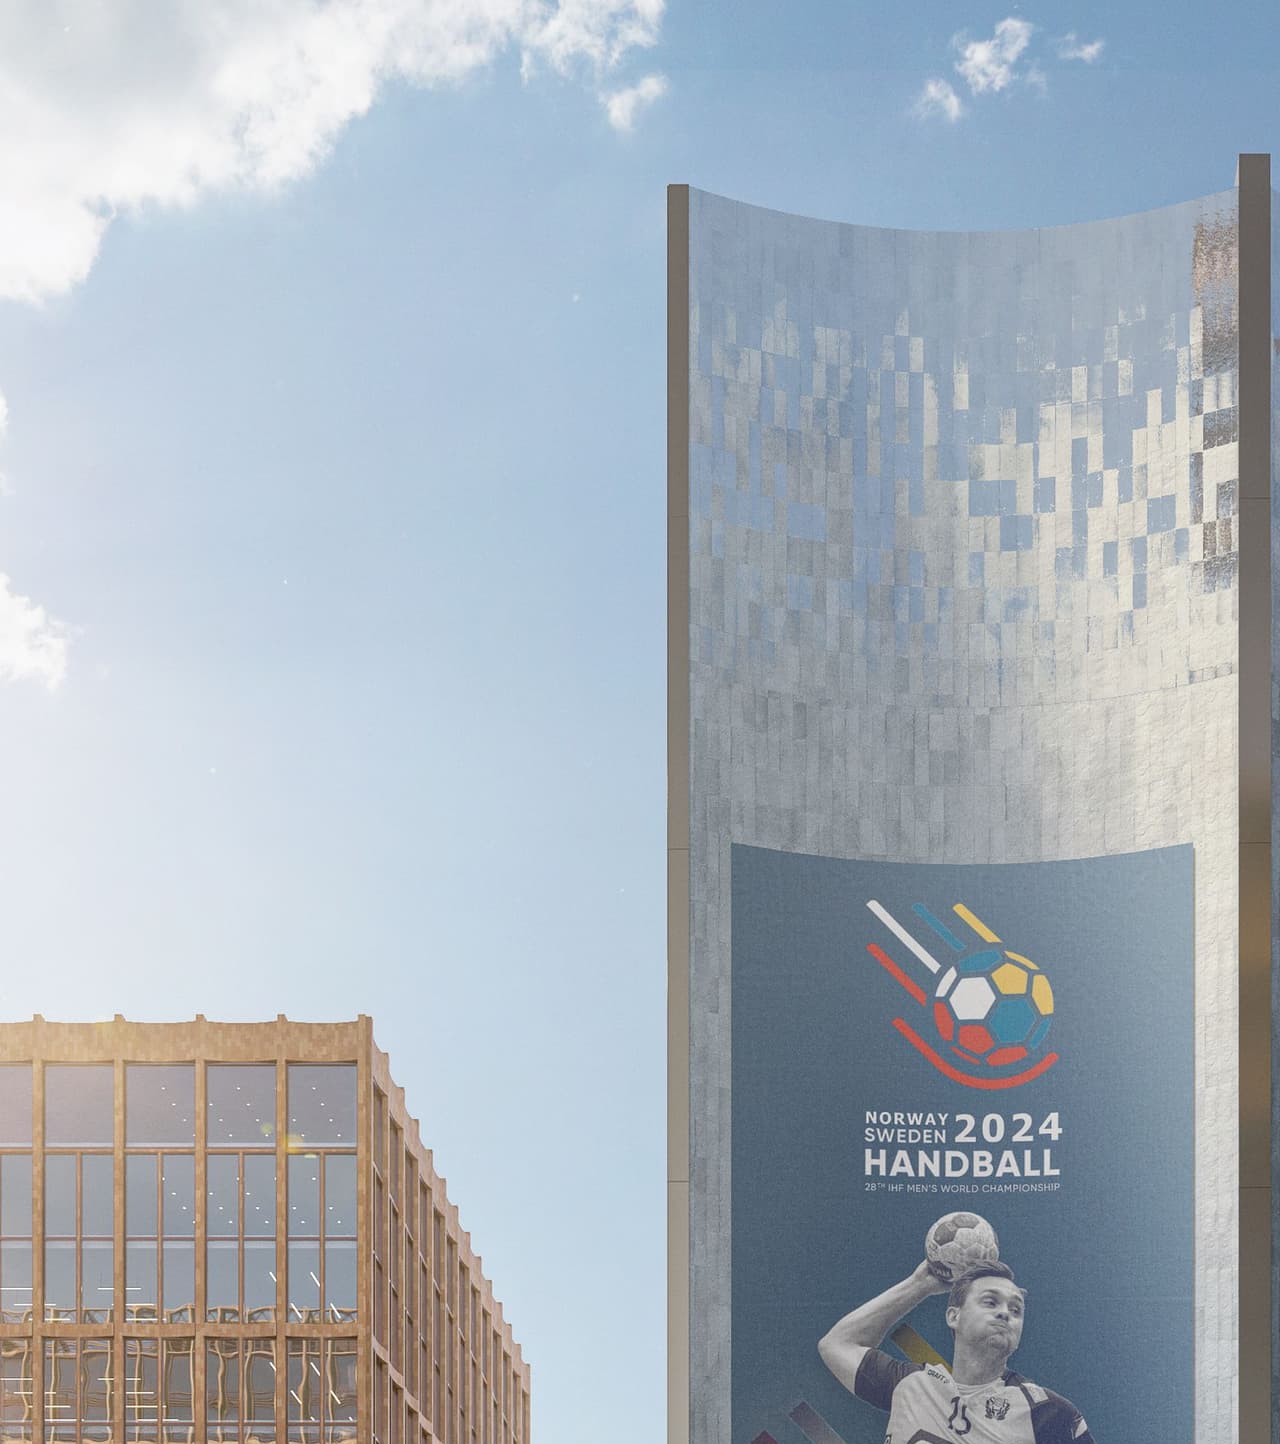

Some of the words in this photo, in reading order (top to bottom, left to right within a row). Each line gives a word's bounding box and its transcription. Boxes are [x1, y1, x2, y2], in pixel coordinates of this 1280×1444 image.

[865, 1111, 949, 1126] NORWAY
[954, 1111, 1063, 1143] 2024
[864, 1127, 947, 1144] SWEDEN
[864, 1148, 1061, 1177] HANDBALL
[888, 1183, 905, 1193] IHF
[906, 1184, 938, 1193] MEN'S
[940, 1184, 979, 1193] WORLD
[981, 1182, 1061, 1193] CHAMPIONSHIP
